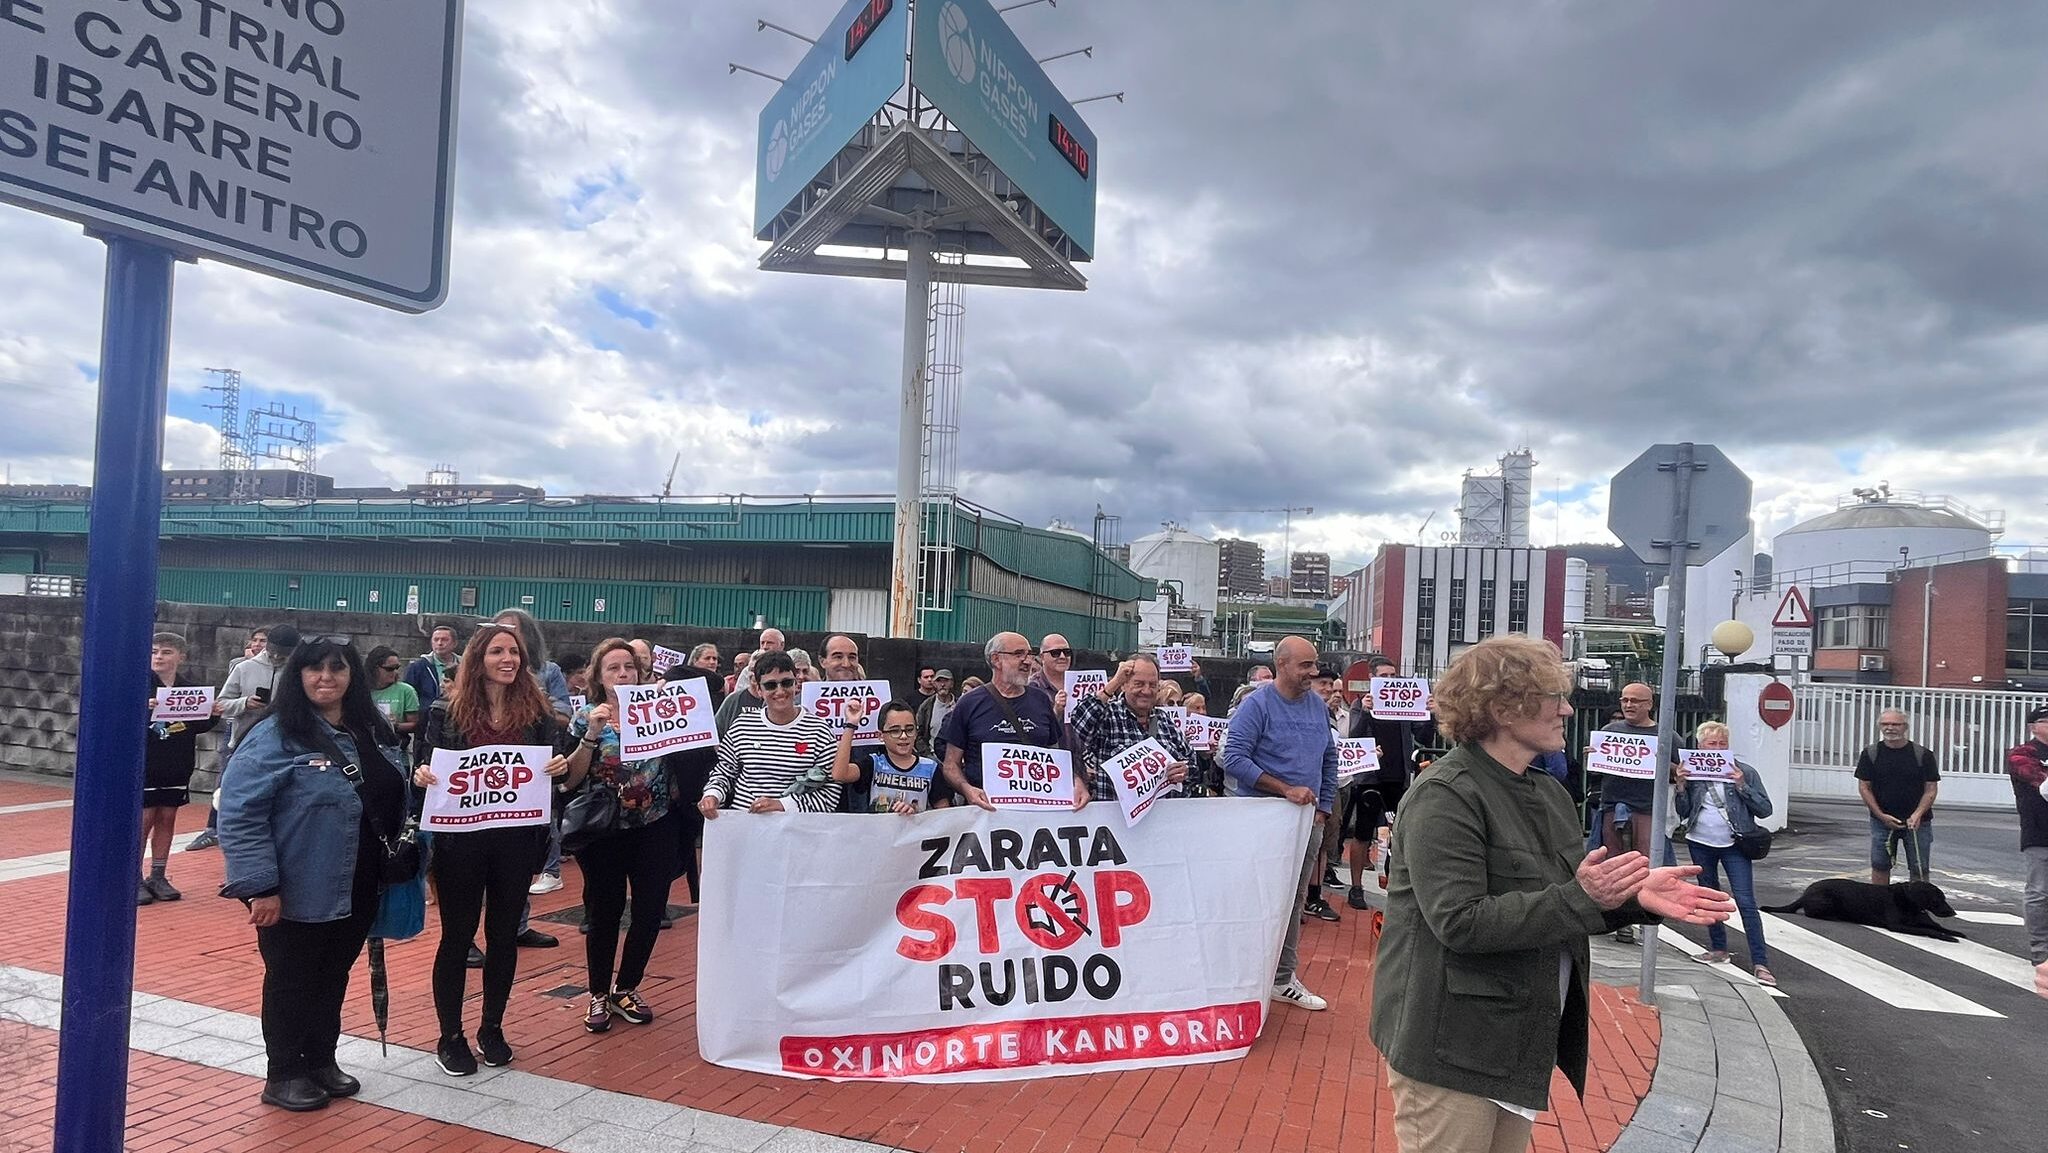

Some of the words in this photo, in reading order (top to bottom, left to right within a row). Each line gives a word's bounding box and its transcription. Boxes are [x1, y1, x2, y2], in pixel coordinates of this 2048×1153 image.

[120, 0, 361, 102] STRIAL
[73, 10, 363, 151] CASERIO
[790, 56, 837, 127] NIPPON
[979, 37, 1038, 124] NIPPON
[979, 74, 1028, 139] GASES
[33, 54, 293, 184] IBARRE
[789, 97, 827, 151] GASES
[1056, 121, 1088, 174] 14:10
[0, 108, 369, 260] SEFANITRO
[656, 653, 680, 664] STOP
[1162, 653, 1188, 661] STOP
[1076, 674, 1104, 683] ZARATA
[1383, 681, 1419, 689] ZARATA
[165, 695, 208, 706] STOP
[629, 685, 688, 703] ZARATA
[820, 685, 875, 698] ZARATA
[1379, 689, 1423, 701] STOP
[627, 695, 697, 726] STOP
[636, 717, 688, 738] RUIDO
[1600, 742, 1651, 759] STOP
[1605, 735, 1647, 746] ZARATA
[458, 751, 526, 770] ZARATA
[1001, 748, 1055, 764] ZARATA
[1117, 745, 1155, 770] ZARATA
[1606, 755, 1642, 766] RUIDO
[1688, 757, 1727, 767] STOP
[997, 759, 1061, 783] STOP
[1122, 751, 1168, 790] STOP
[1695, 765, 1722, 773] RUIDO
[447, 765, 535, 796] STOP
[1009, 779, 1053, 794] RUIDO
[459, 790, 518, 809] RUIDO
[918, 824, 1128, 880] ZARATA
[895, 869, 1152, 963] STOP
[938, 952, 1123, 1012] RUIDO
[804, 1029, 1020, 1072] OXINORTE
[1045, 1011, 1247, 1058] KANPORA!
